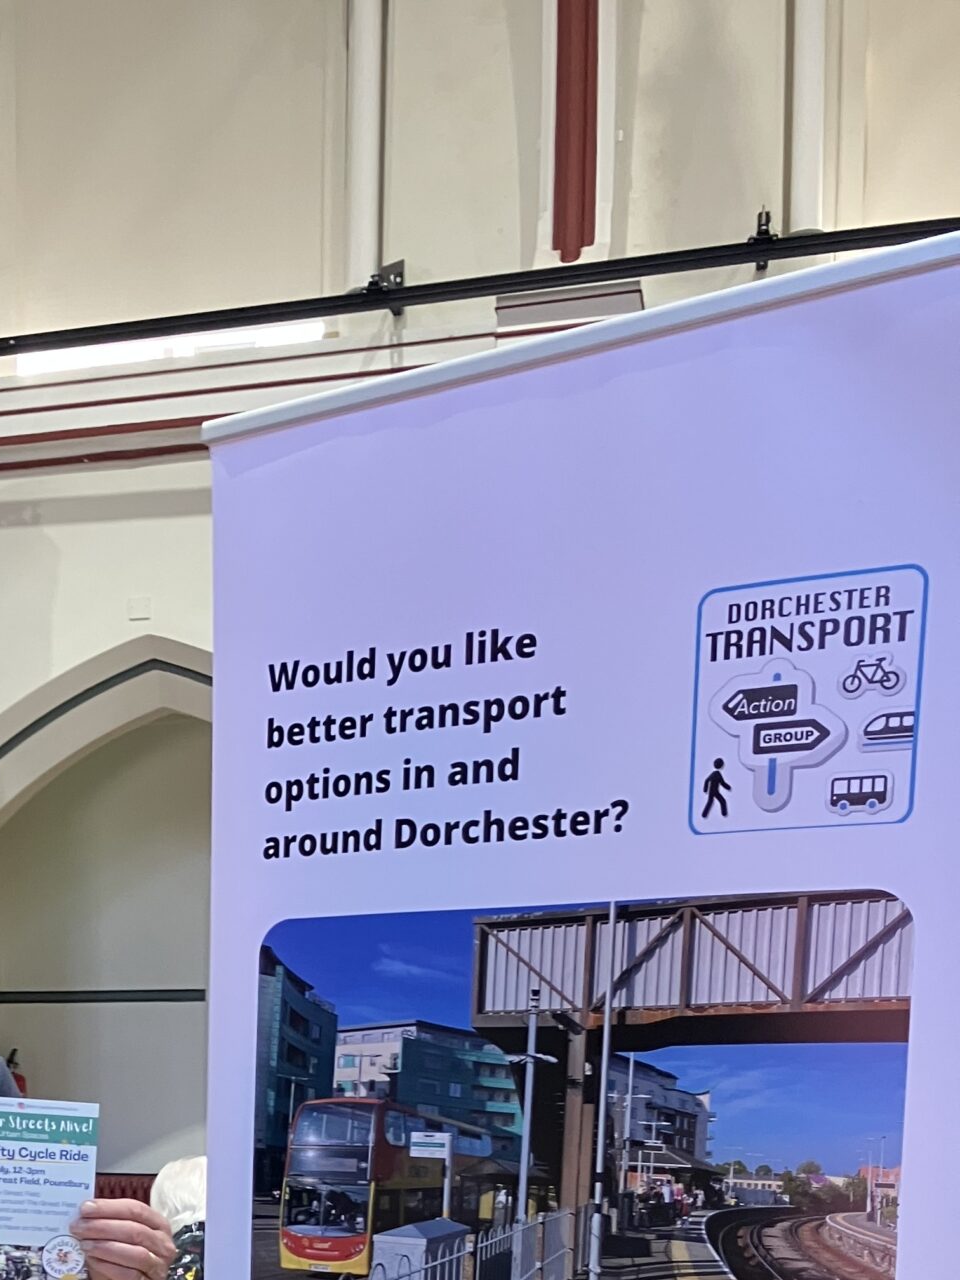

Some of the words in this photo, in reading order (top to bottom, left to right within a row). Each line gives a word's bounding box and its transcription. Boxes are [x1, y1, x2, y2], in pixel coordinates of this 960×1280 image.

[728, 586, 890, 624] DORCHESTER
[706, 610, 914, 662] TRANSPORT
[268, 647, 377, 692] Would
[386, 644, 452, 686] you
[465, 628, 537, 665] like
[267, 713, 373, 748] better
[383, 686, 567, 733] transport
[734, 697, 795, 715] Action
[763, 730, 814, 744] GROUP
[265, 768, 391, 811] options
[402, 758, 435, 790] in
[448, 748, 519, 786] and
[263, 819, 382, 859] around
[394, 799, 629, 848] Dorchester?
[9, 1116, 56, 1131] Streets
[60, 1119, 93, 1132] Alive!
[19, 1147, 56, 1161] Cycle
[60, 1151, 88, 1162] Ride
